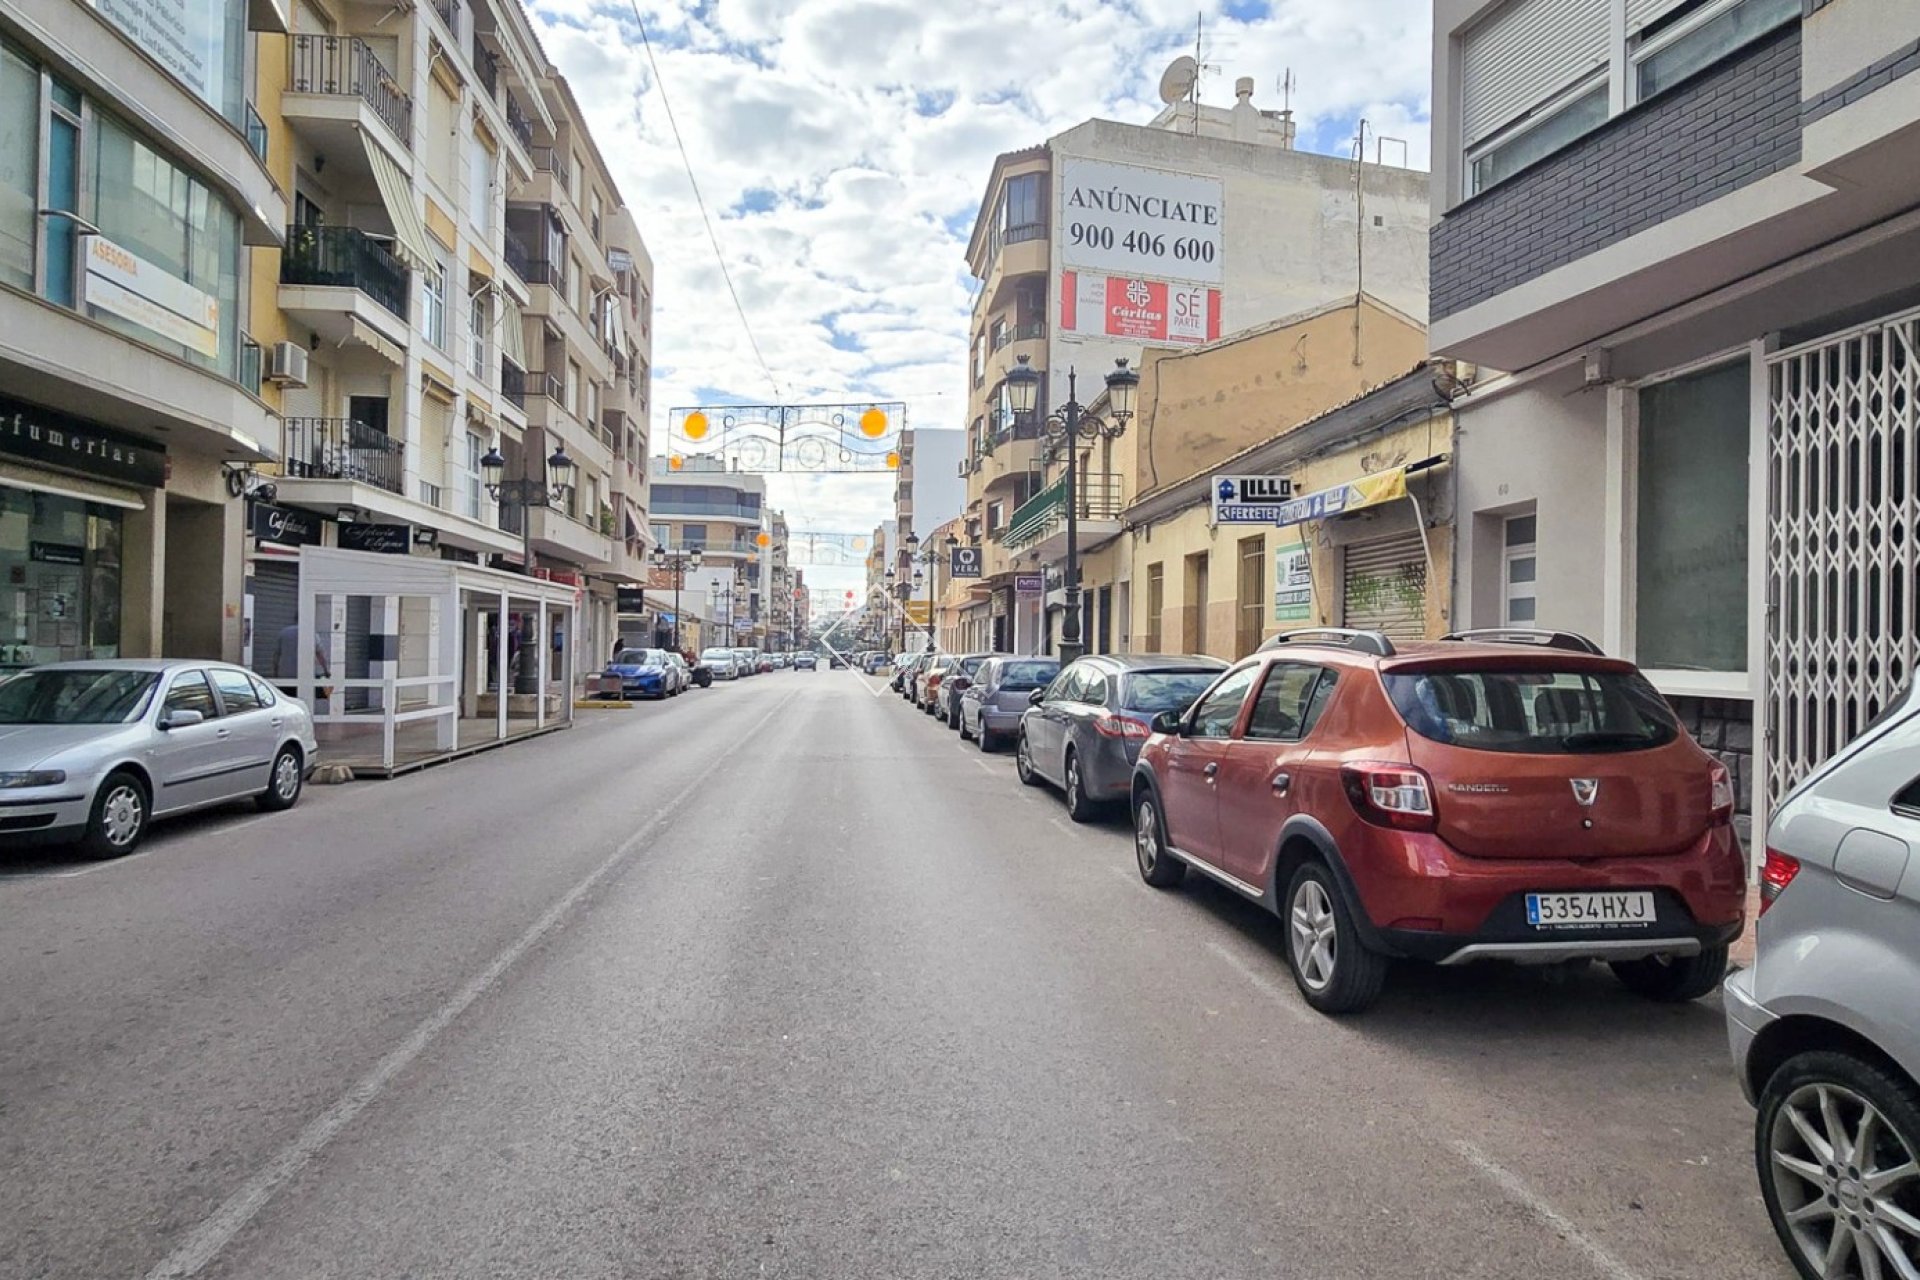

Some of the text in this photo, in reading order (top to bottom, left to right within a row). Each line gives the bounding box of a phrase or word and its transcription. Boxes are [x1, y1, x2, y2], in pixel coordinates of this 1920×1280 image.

[1068, 186, 1218, 226] ANÚNCIATE
[1071, 222, 1215, 263] 900 406 600
[1175, 288, 1201, 318] SÉ
[1173, 317, 1201, 330] PARTE
[1240, 479, 1292, 503] LILLO
[1230, 505, 1280, 521] FERRETER
[953, 564, 980, 573] VERA
